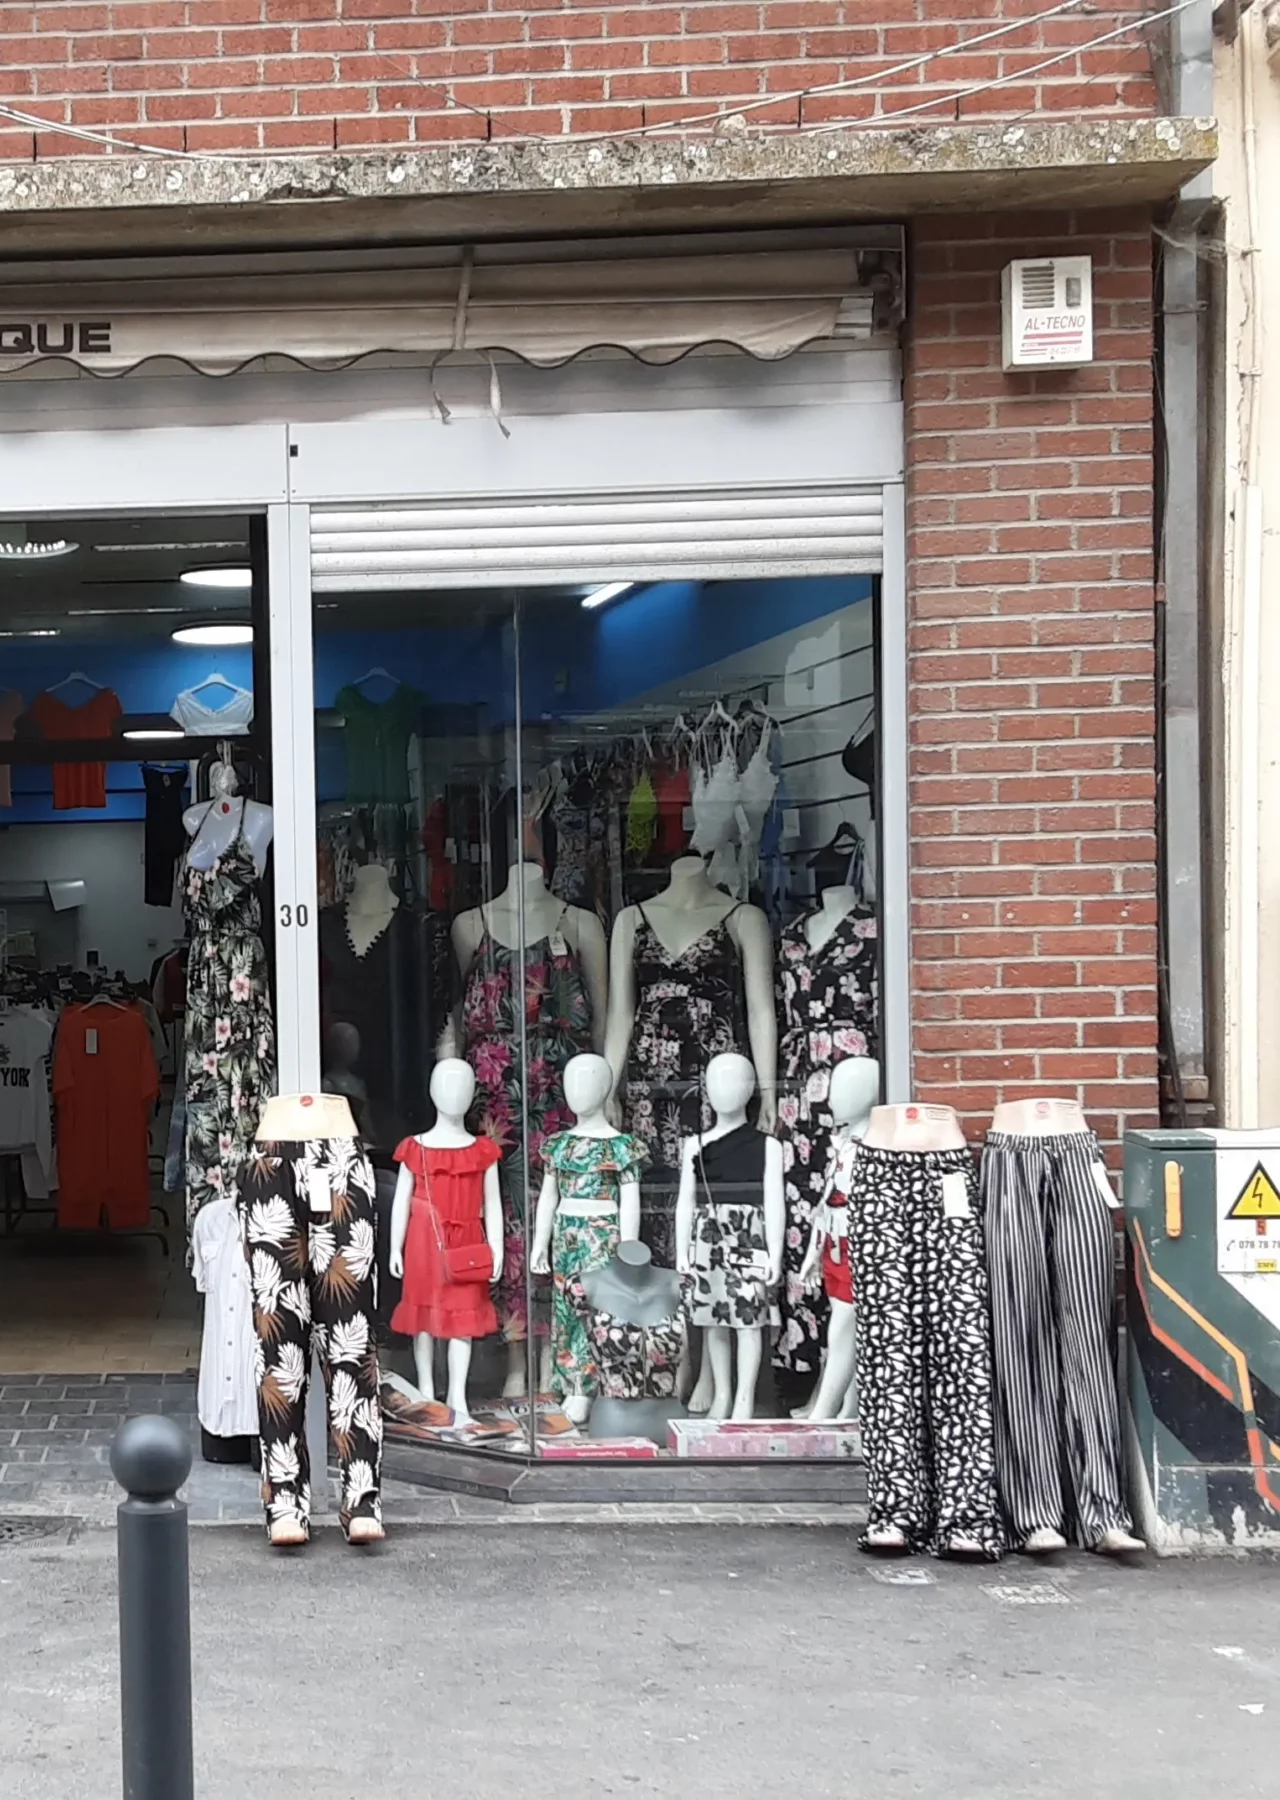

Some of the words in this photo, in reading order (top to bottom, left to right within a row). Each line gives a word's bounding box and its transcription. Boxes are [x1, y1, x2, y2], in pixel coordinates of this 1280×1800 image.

[1024, 314, 1086, 331] AL-TECNO
[280, 903, 308, 928] 30
[0, 1066, 31, 1088] YORK
